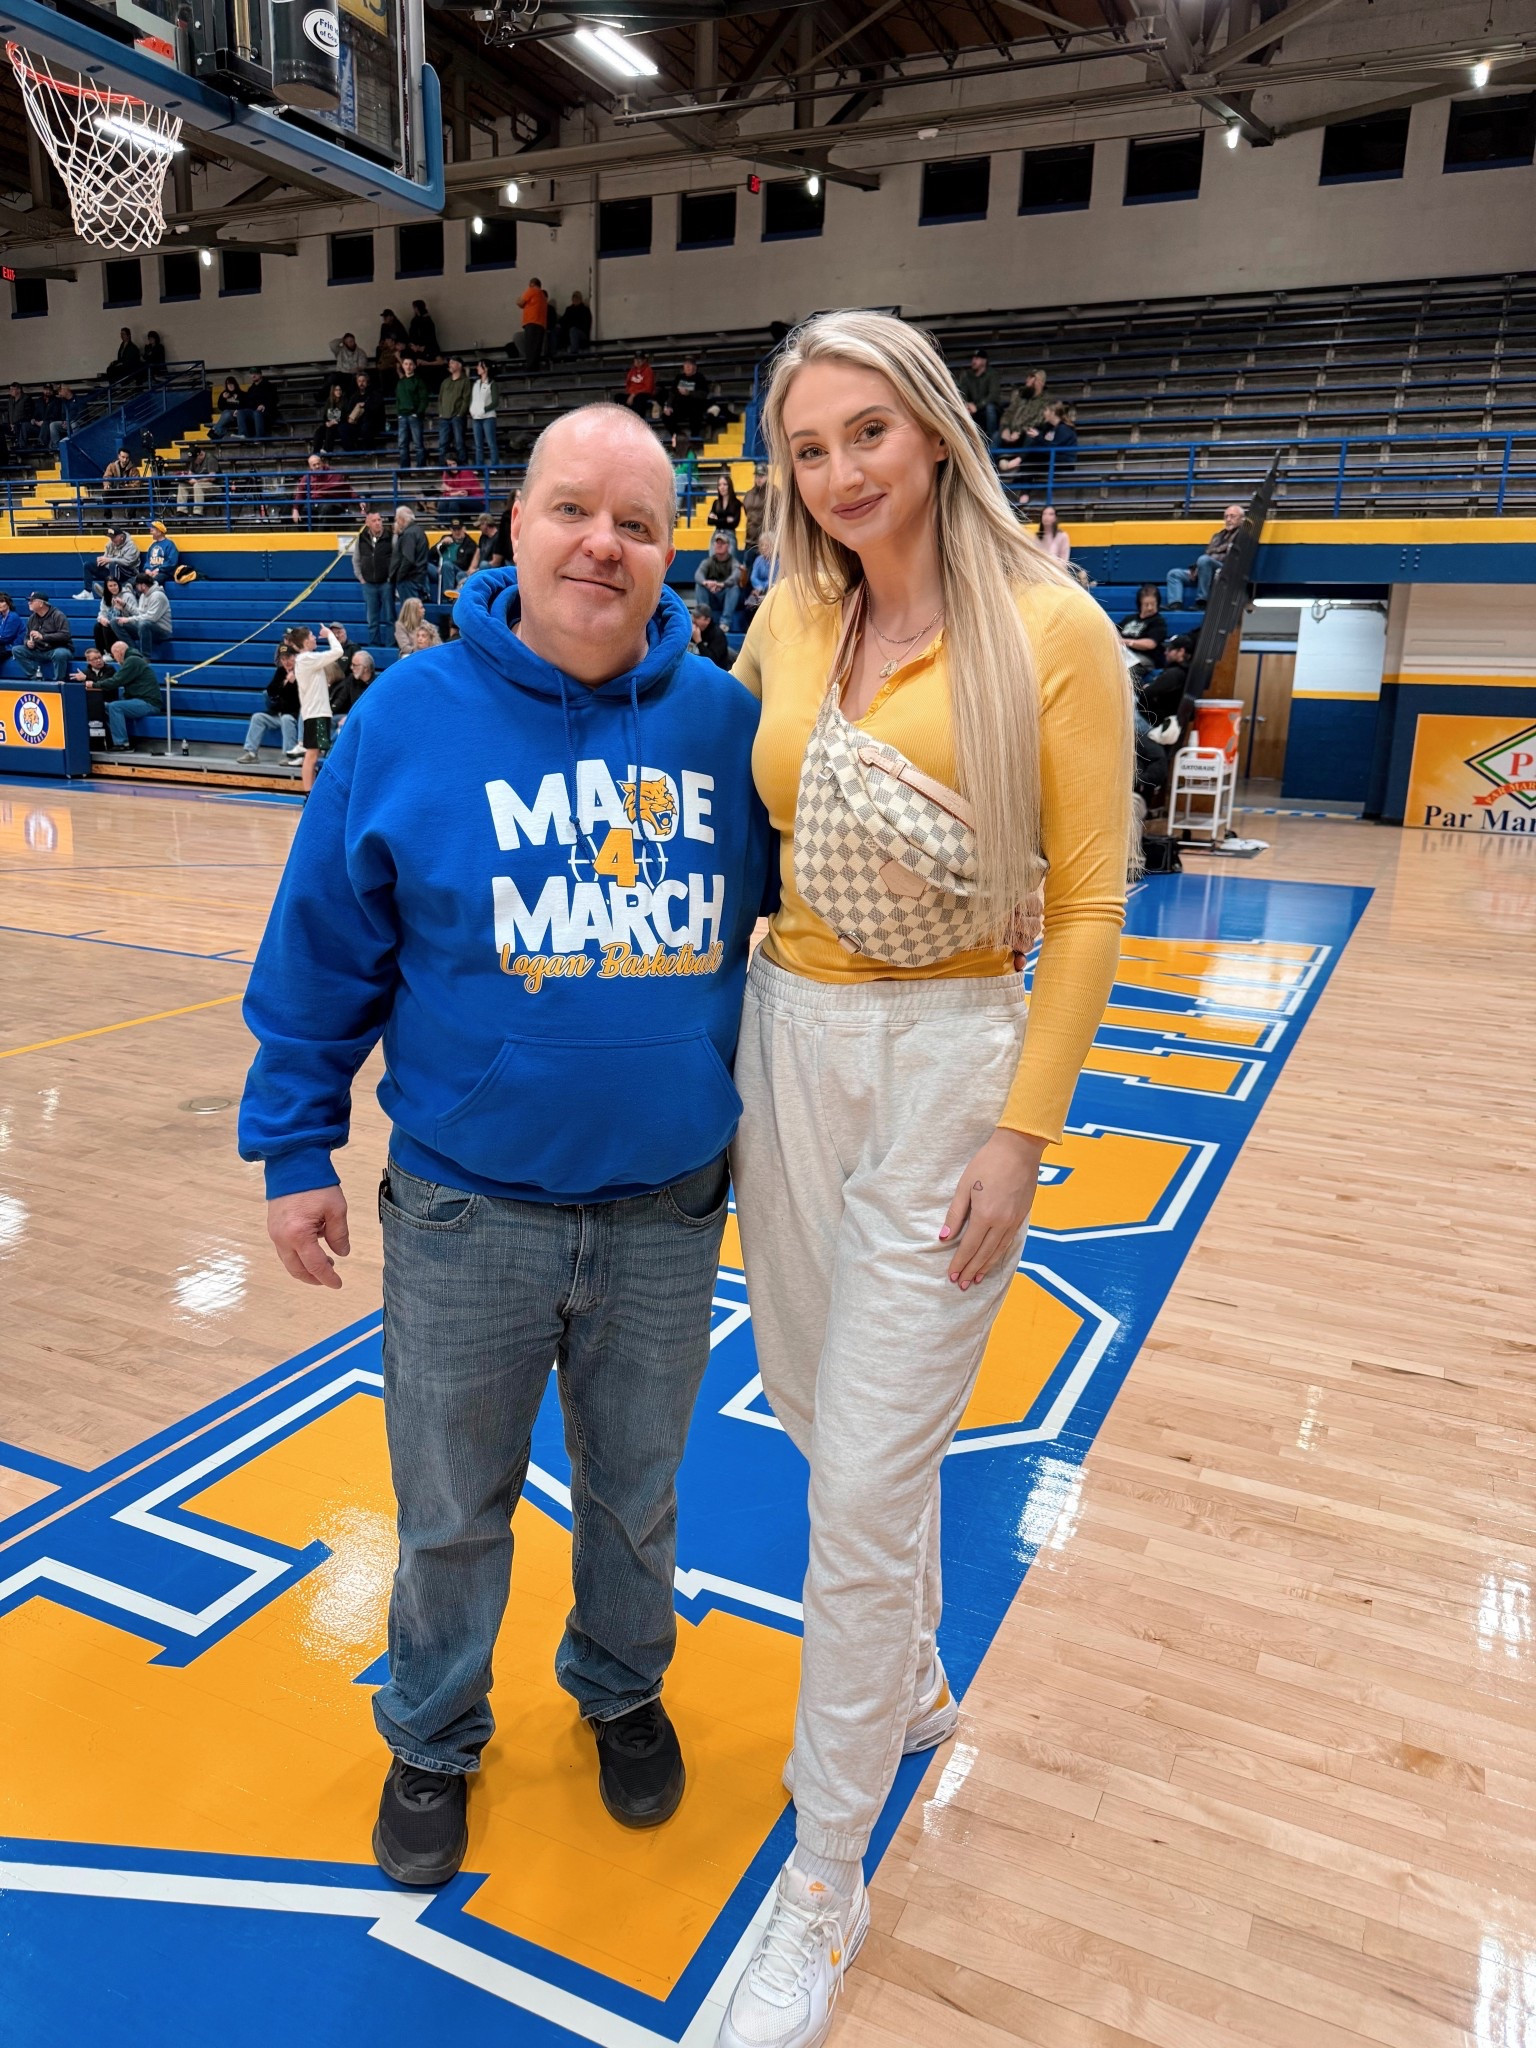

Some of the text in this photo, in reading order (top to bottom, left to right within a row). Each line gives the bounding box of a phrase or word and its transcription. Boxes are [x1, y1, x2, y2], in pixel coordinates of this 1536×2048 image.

[484, 758, 715, 851] MADE
[1422, 805, 1473, 828] Par
[1485, 787, 1505, 804] PAR
[592, 827, 639, 888] 4
[491, 872, 725, 957] MARCH
[499, 940, 725, 994] Logan Basketball
